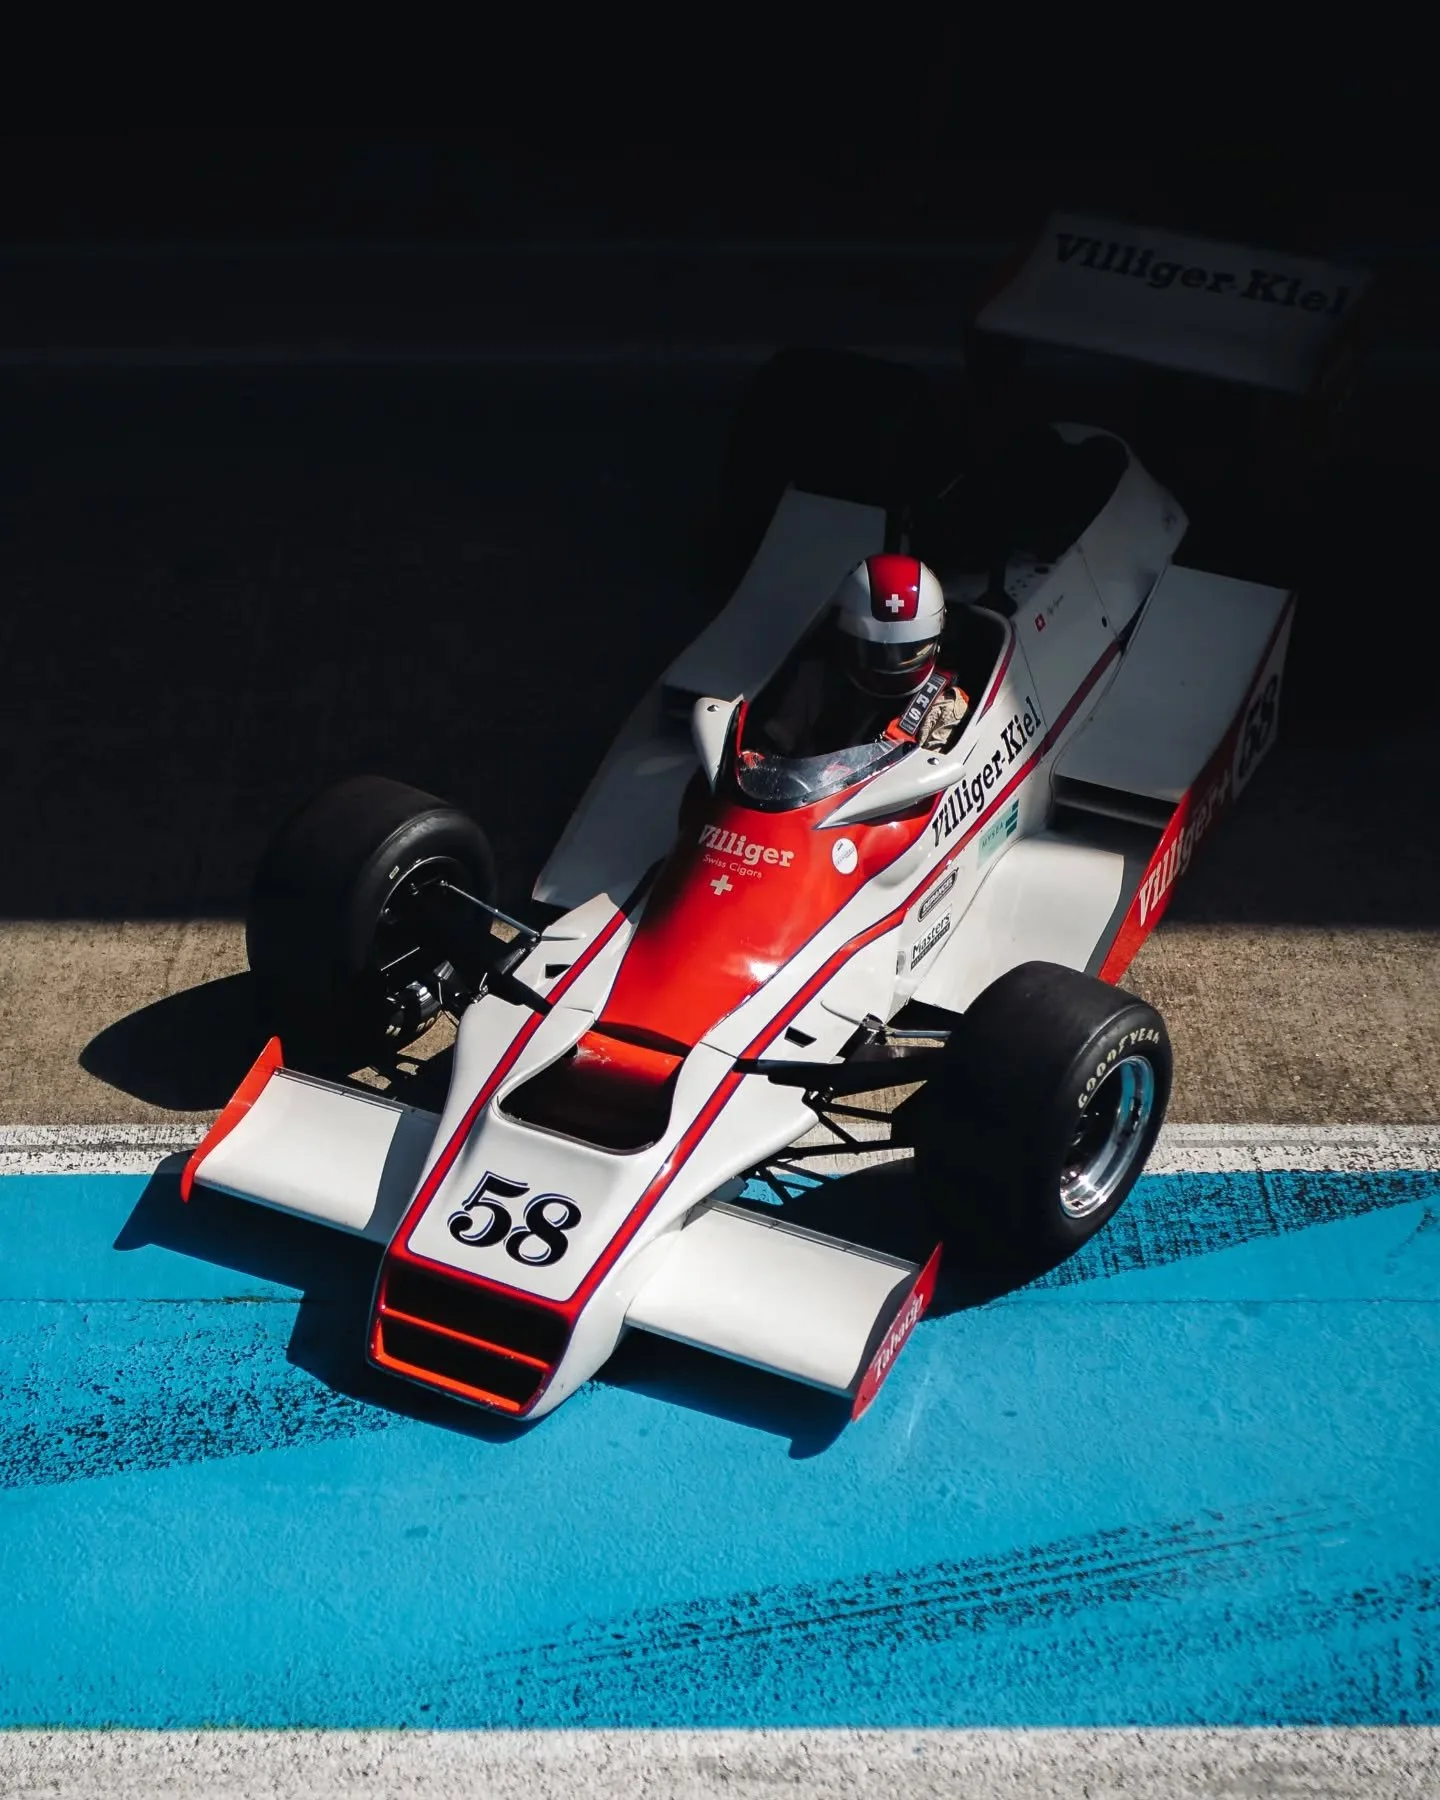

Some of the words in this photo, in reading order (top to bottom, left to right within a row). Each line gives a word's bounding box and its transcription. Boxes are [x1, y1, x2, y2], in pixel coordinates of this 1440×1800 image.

[908, 682, 939, 721] TRS
[931, 696, 1042, 848] Villiger-Kiel
[699, 824, 795, 868] Villiger
[703, 854, 727, 869] Swiss
[729, 861, 763, 879] Cigars
[912, 913, 951, 960] Masters
[447, 1170, 582, 1268] 58
